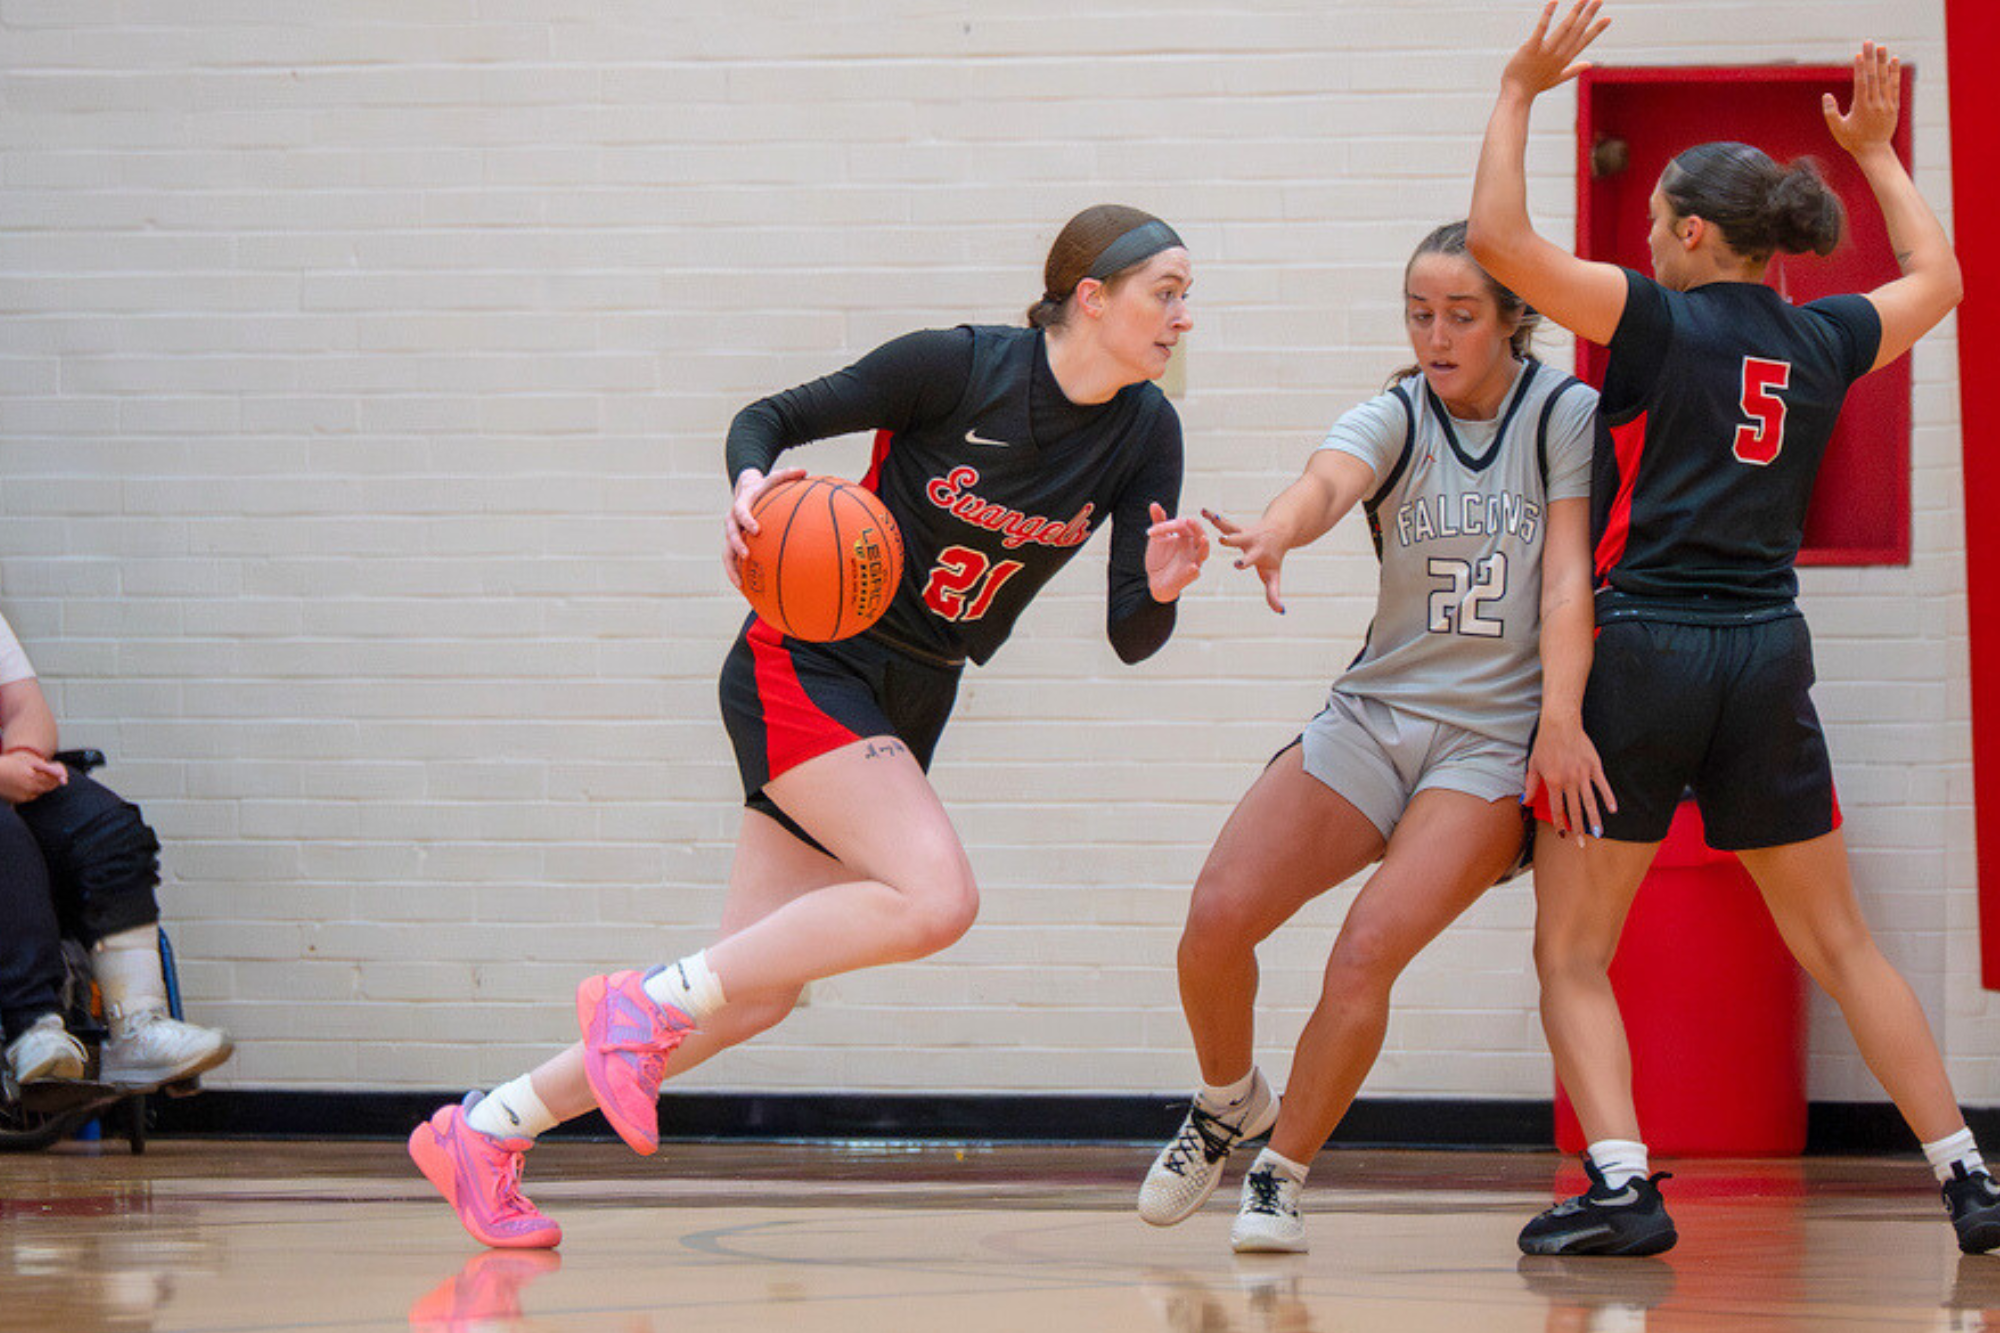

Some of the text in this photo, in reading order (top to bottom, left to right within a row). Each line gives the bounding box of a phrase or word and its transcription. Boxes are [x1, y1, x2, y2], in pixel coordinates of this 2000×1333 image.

[1732, 356, 1791, 465] 5
[922, 545, 1025, 622] 21
[1428, 551, 1508, 638] 22
